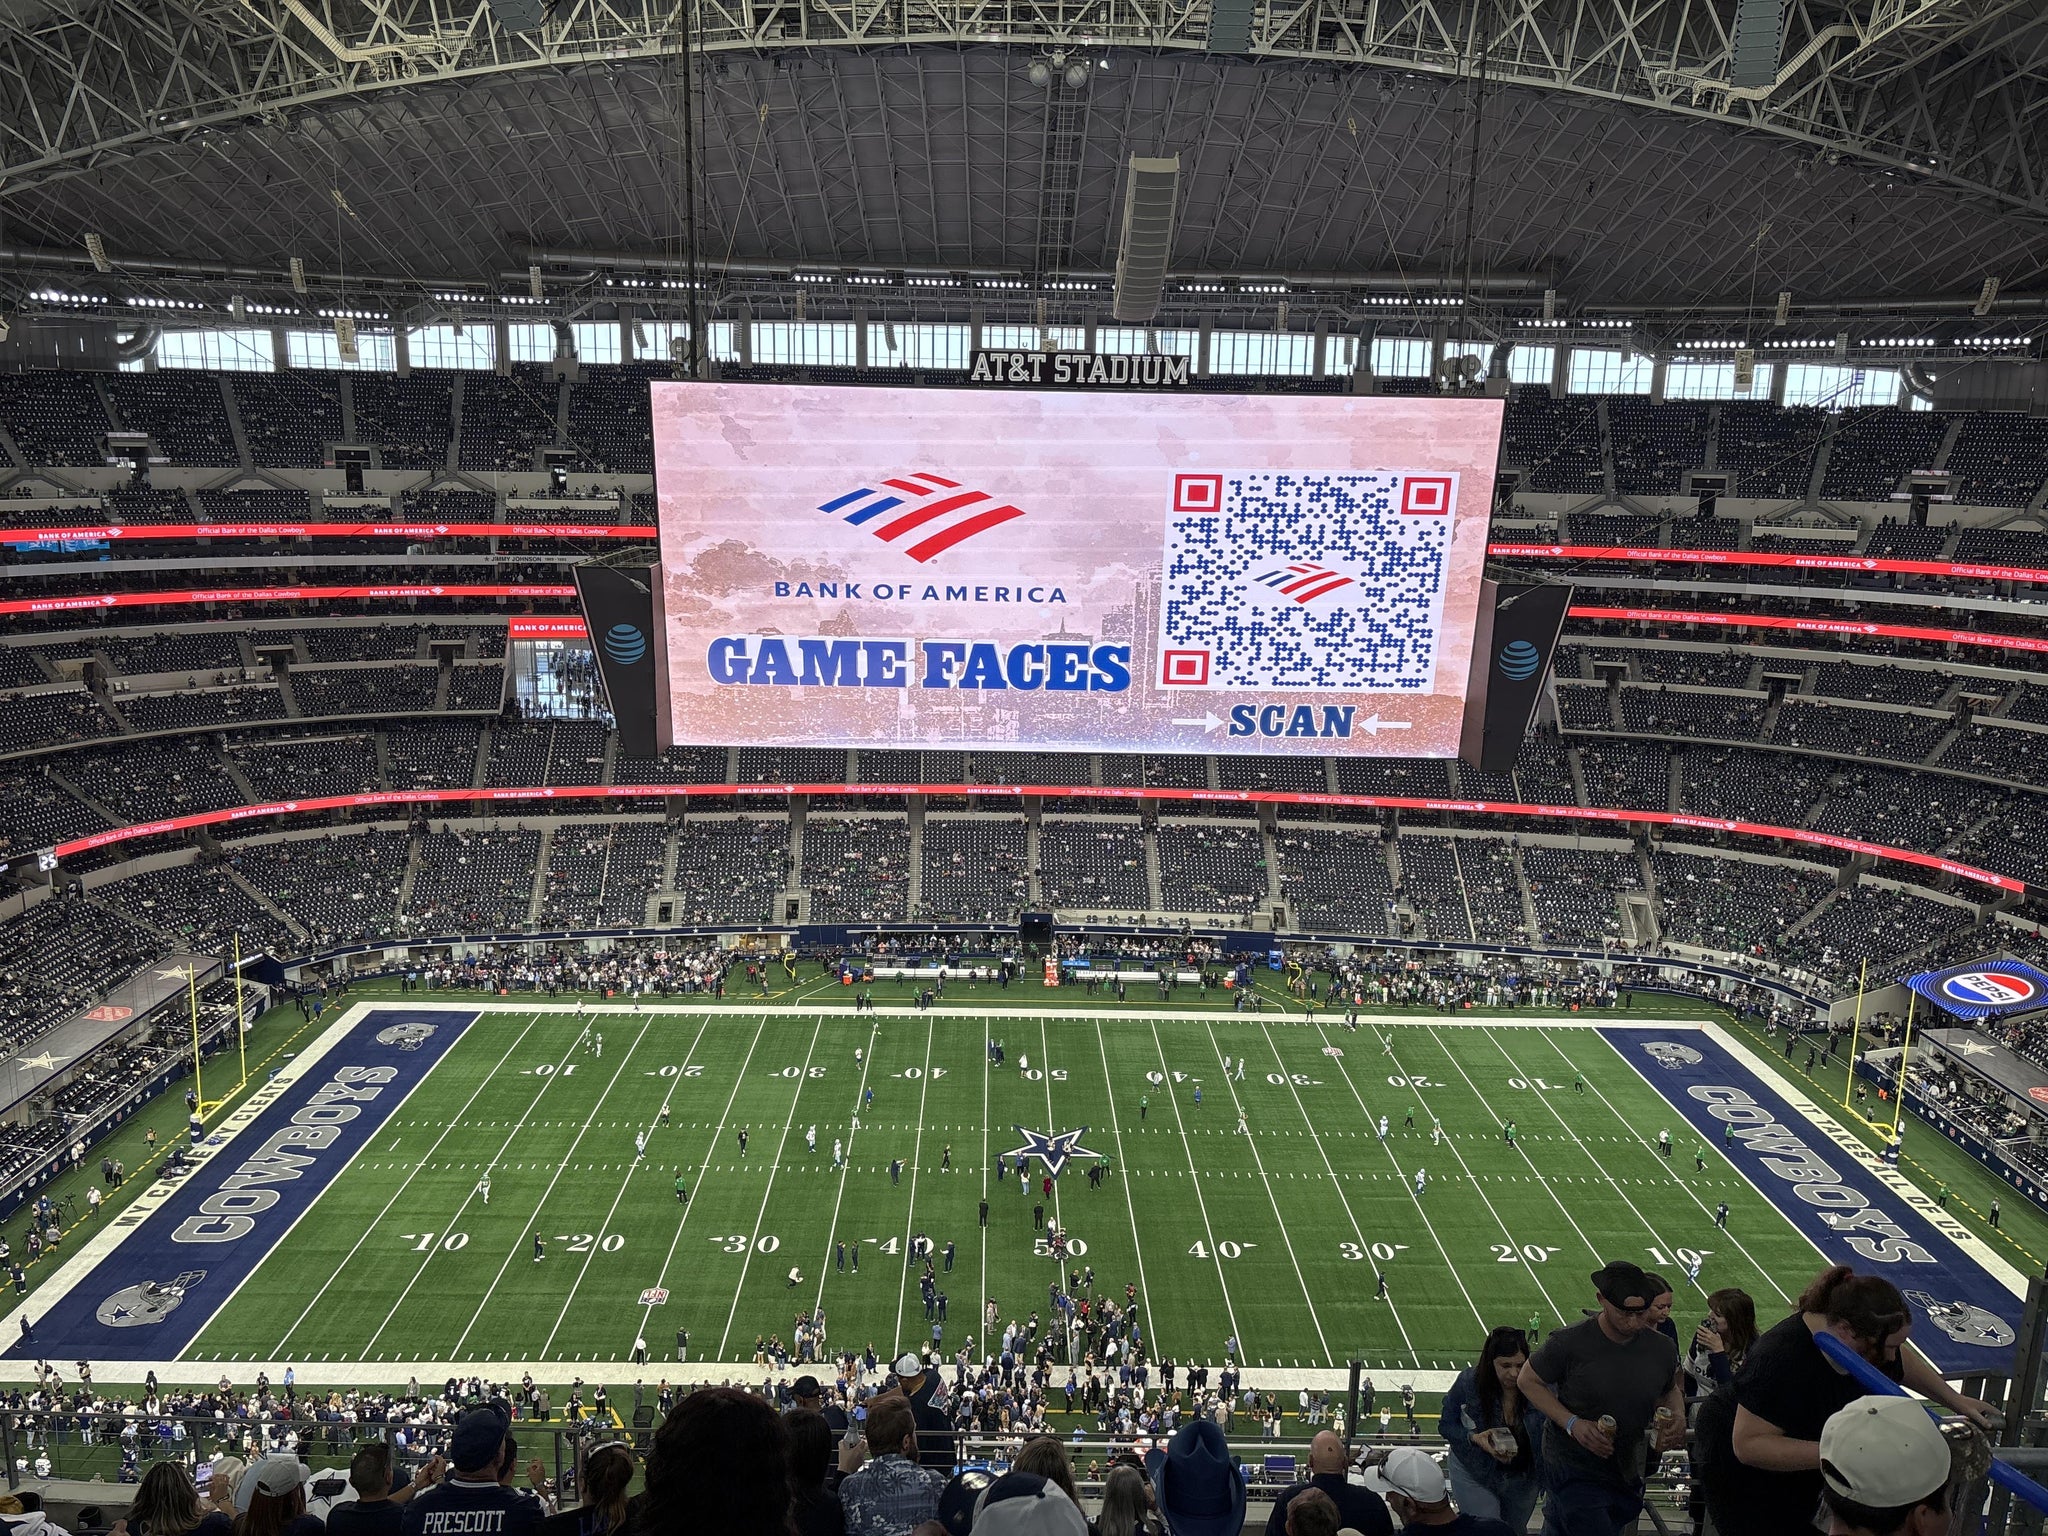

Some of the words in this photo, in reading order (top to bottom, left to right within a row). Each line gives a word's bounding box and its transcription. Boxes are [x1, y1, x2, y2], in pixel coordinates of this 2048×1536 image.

[971, 353, 1046, 382] AT&T
[1054, 355, 1189, 384] STADIUM
[775, 581, 862, 600] BANK
[873, 583, 911, 600] OF
[921, 585, 1067, 603] AMERICA
[707, 634, 913, 688] GAME
[922, 637, 1133, 692] FACES
[1227, 704, 1356, 737] SCAN
[256, 806, 285, 815] AMERICA
[1697, 821, 1724, 829] AMERICA
[1941, 863, 1957, 873] BANK
[1965, 870, 1989, 881] AMERICA
[1962, 976, 2016, 1001] PEPSI
[535, 1064, 579, 1076] 10
[659, 1065, 705, 1077] 20
[783, 1066, 827, 1078] 30
[904, 1067, 948, 1080] 40
[1026, 1069, 1069, 1082] 50
[1266, 1073, 1311, 1086] 30
[1387, 1075, 1432, 1088] 20
[1508, 1077, 1554, 1090] 10
[113, 1205, 148, 1227] MY
[147, 1151, 214, 1197] CAE
[232, 1078, 294, 1121] CLEATS
[171, 1066, 398, 1243] COWBOYS
[1687, 1085, 1938, 1263] COWBOYS
[1795, 1104, 1822, 1115] IT
[1817, 1120, 1874, 1159] TAKES
[1869, 1165, 1909, 1190] ALL
[1907, 1196, 1940, 1214] OF
[1936, 1221, 1972, 1240] US
[410, 1232, 469, 1251] 10
[565, 1233, 625, 1252] 20
[724, 1235, 781, 1254] 30
[1033, 1238, 1088, 1256] 50
[1188, 1240, 1242, 1258] 40
[1339, 1242, 1396, 1261] 30
[1489, 1244, 1549, 1262] 20
[422, 1510, 506, 1534] PRESCOTT
